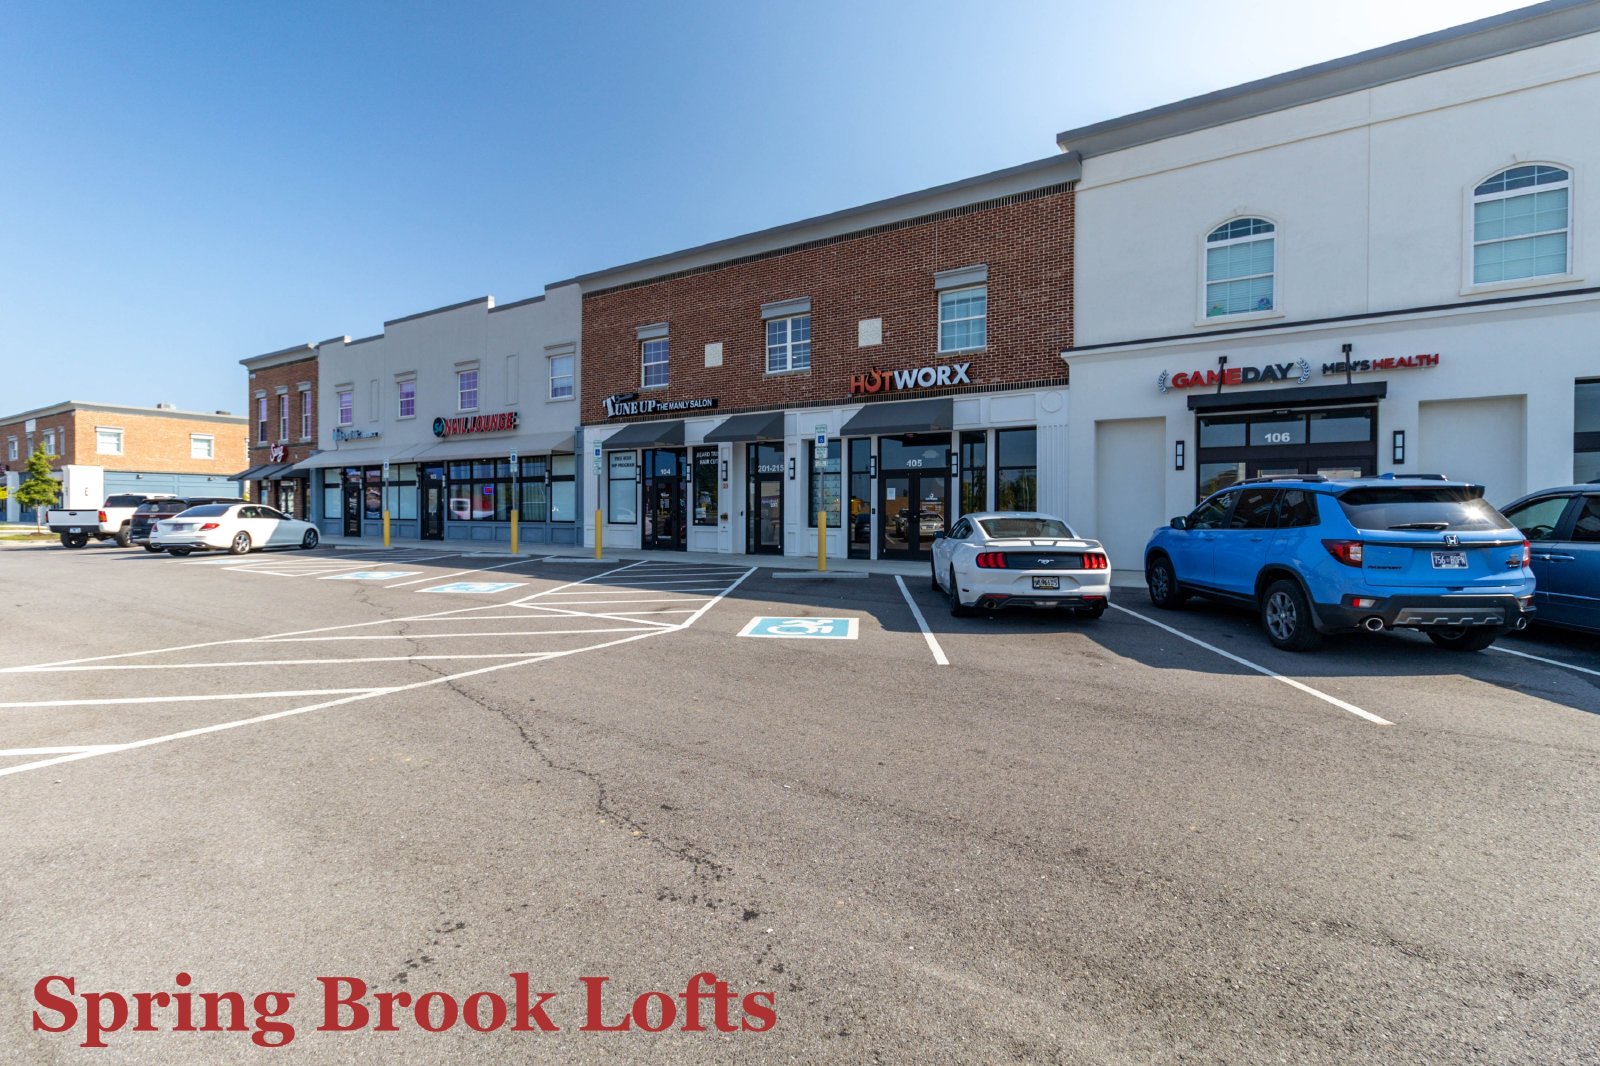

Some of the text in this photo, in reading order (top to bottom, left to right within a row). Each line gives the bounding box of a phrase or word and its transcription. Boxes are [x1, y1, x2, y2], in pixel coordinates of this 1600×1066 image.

[850, 362, 971, 393] HOTWORX
[1171, 353, 1439, 388] GAMEDAY MEN'S HEALTH
[656, 403, 669, 411] THE
[668, 400, 690, 410] MANLY
[689, 398, 713, 408] SALON
[445, 416, 467, 436] NAIL
[469, 411, 514, 433] LOUNGE
[1264, 432, 1291, 443] 106
[757, 464, 785, 473] 201-215
